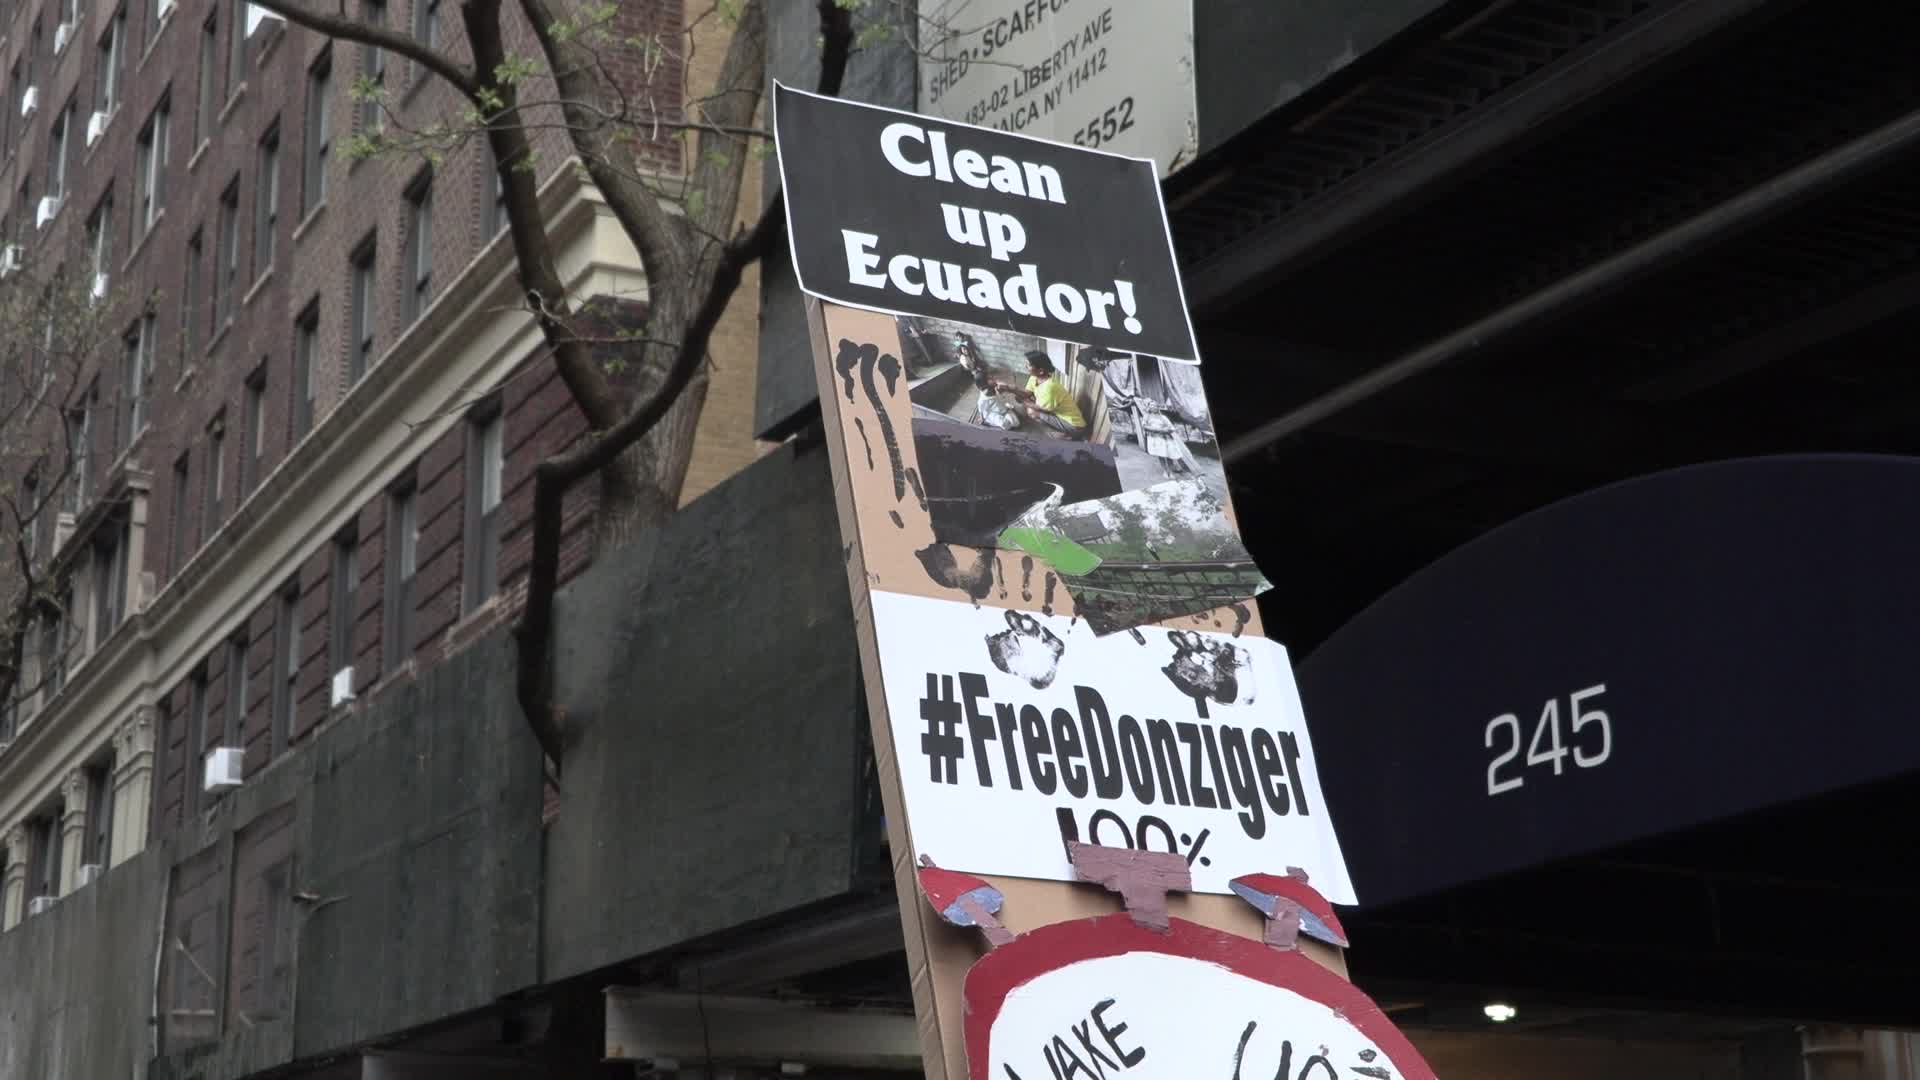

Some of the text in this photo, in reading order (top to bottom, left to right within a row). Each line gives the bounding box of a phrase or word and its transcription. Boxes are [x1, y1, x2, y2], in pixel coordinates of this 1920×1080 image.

[1014, 33, 1079, 98] LIBERTY
[1082, 8, 1112, 49] AVE
[1044, 82, 1063, 114] NY
[1067, 48, 1107, 94] 11412
[880, 122, 1067, 204] Clean
[941, 202, 1026, 261] up
[841, 229, 1142, 335] Ecuador!
[920, 672, 1310, 840] #FreeDonziger
[1485, 684, 1611, 796] 245
